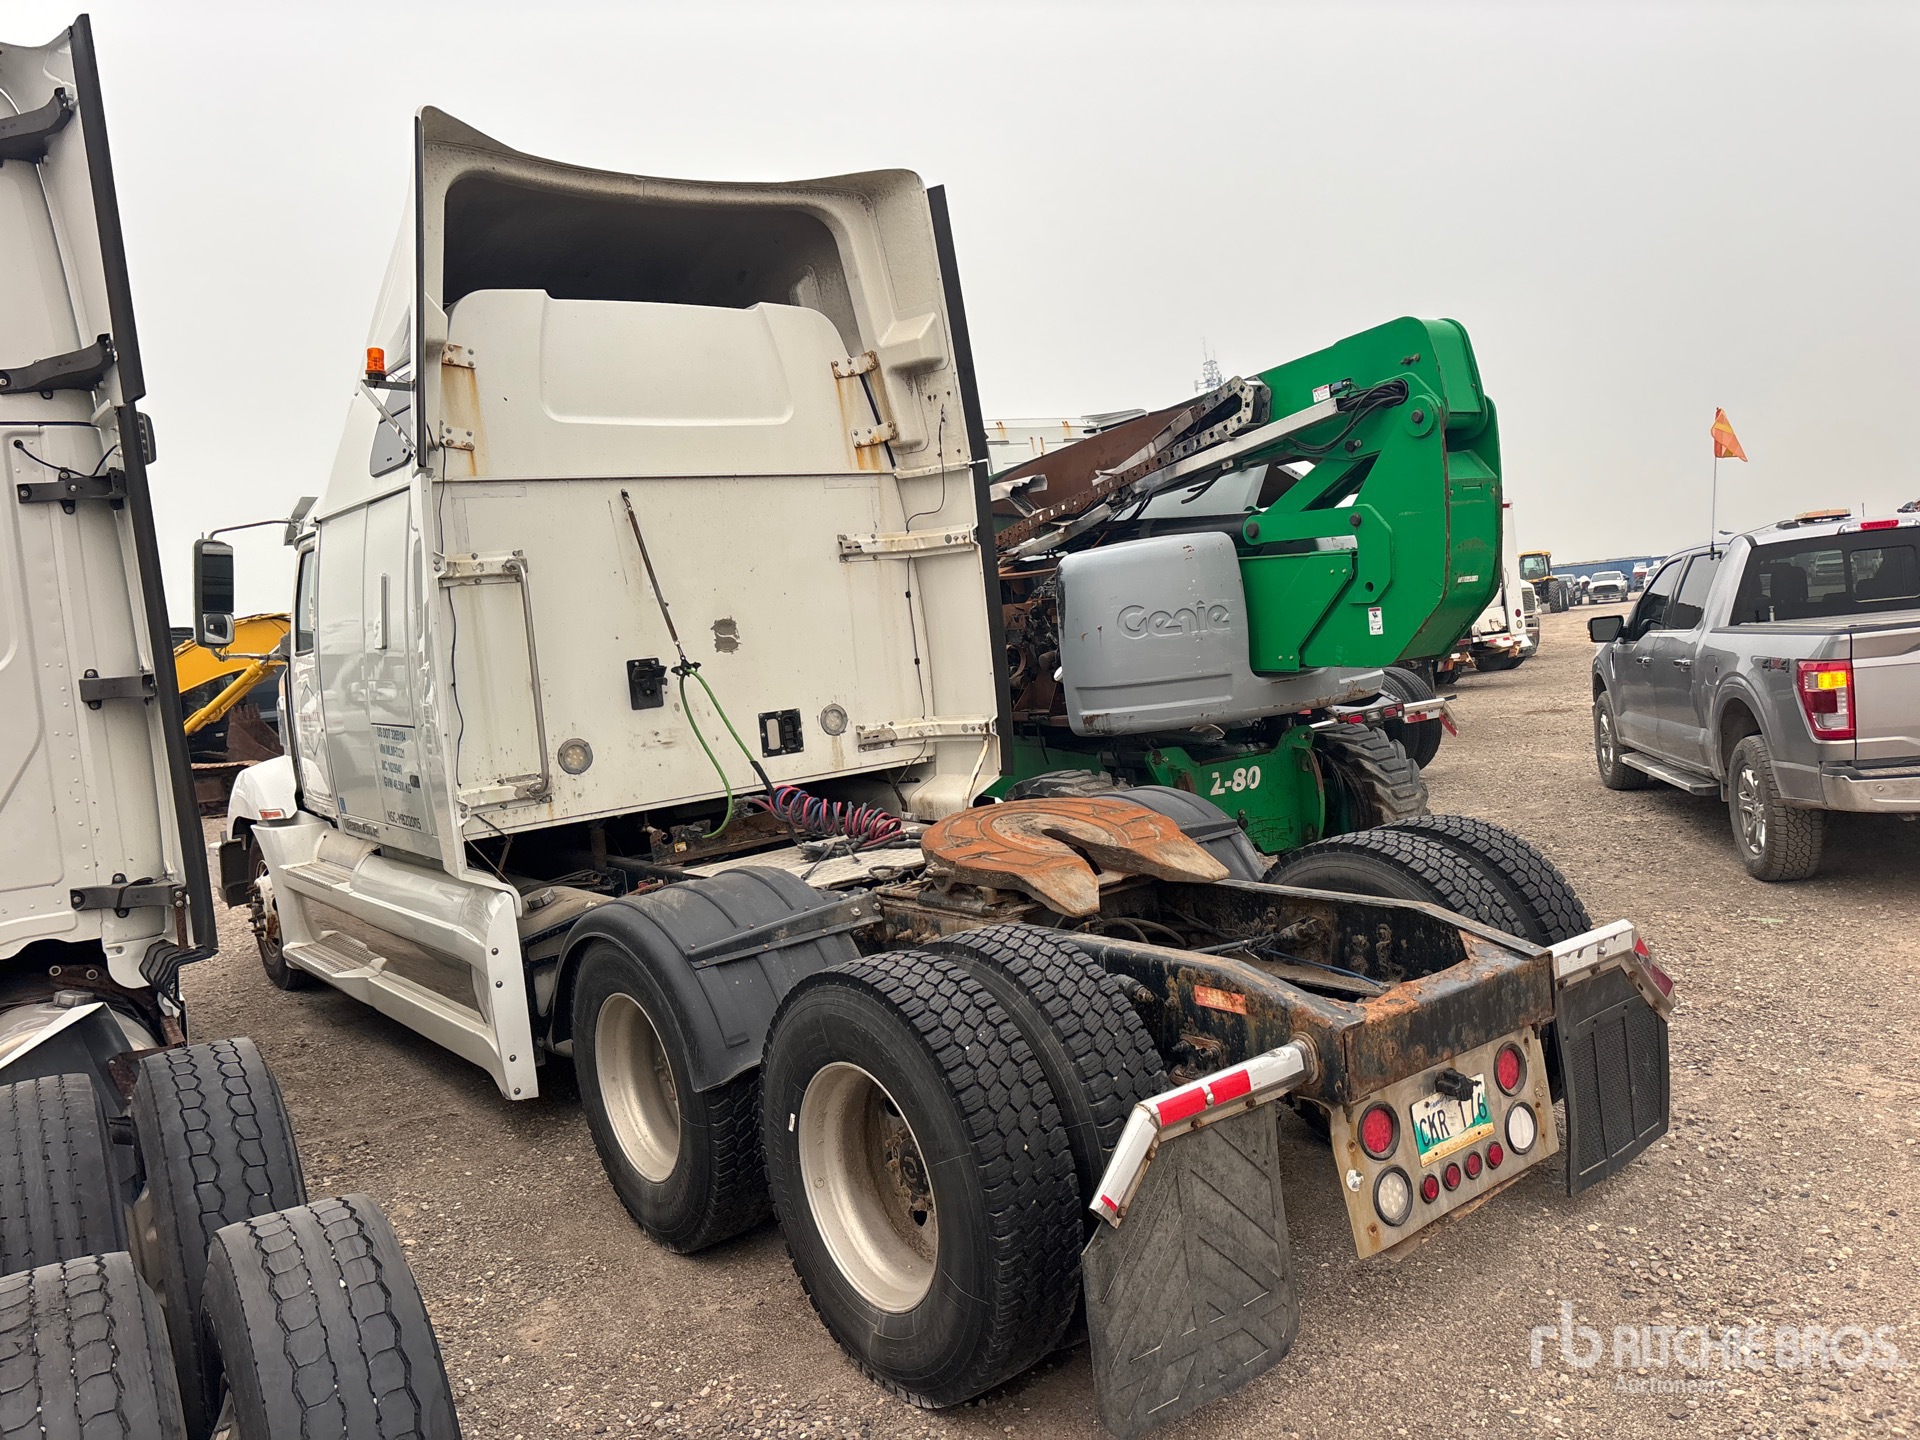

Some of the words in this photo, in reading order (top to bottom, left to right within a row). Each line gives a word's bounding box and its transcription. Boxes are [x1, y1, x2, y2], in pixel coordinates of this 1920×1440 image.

[1117, 600, 1231, 639] Genie
[377, 727, 383, 738] US
[383, 727, 391, 739] DOT
[1419, 1109, 1451, 1147] CKR
